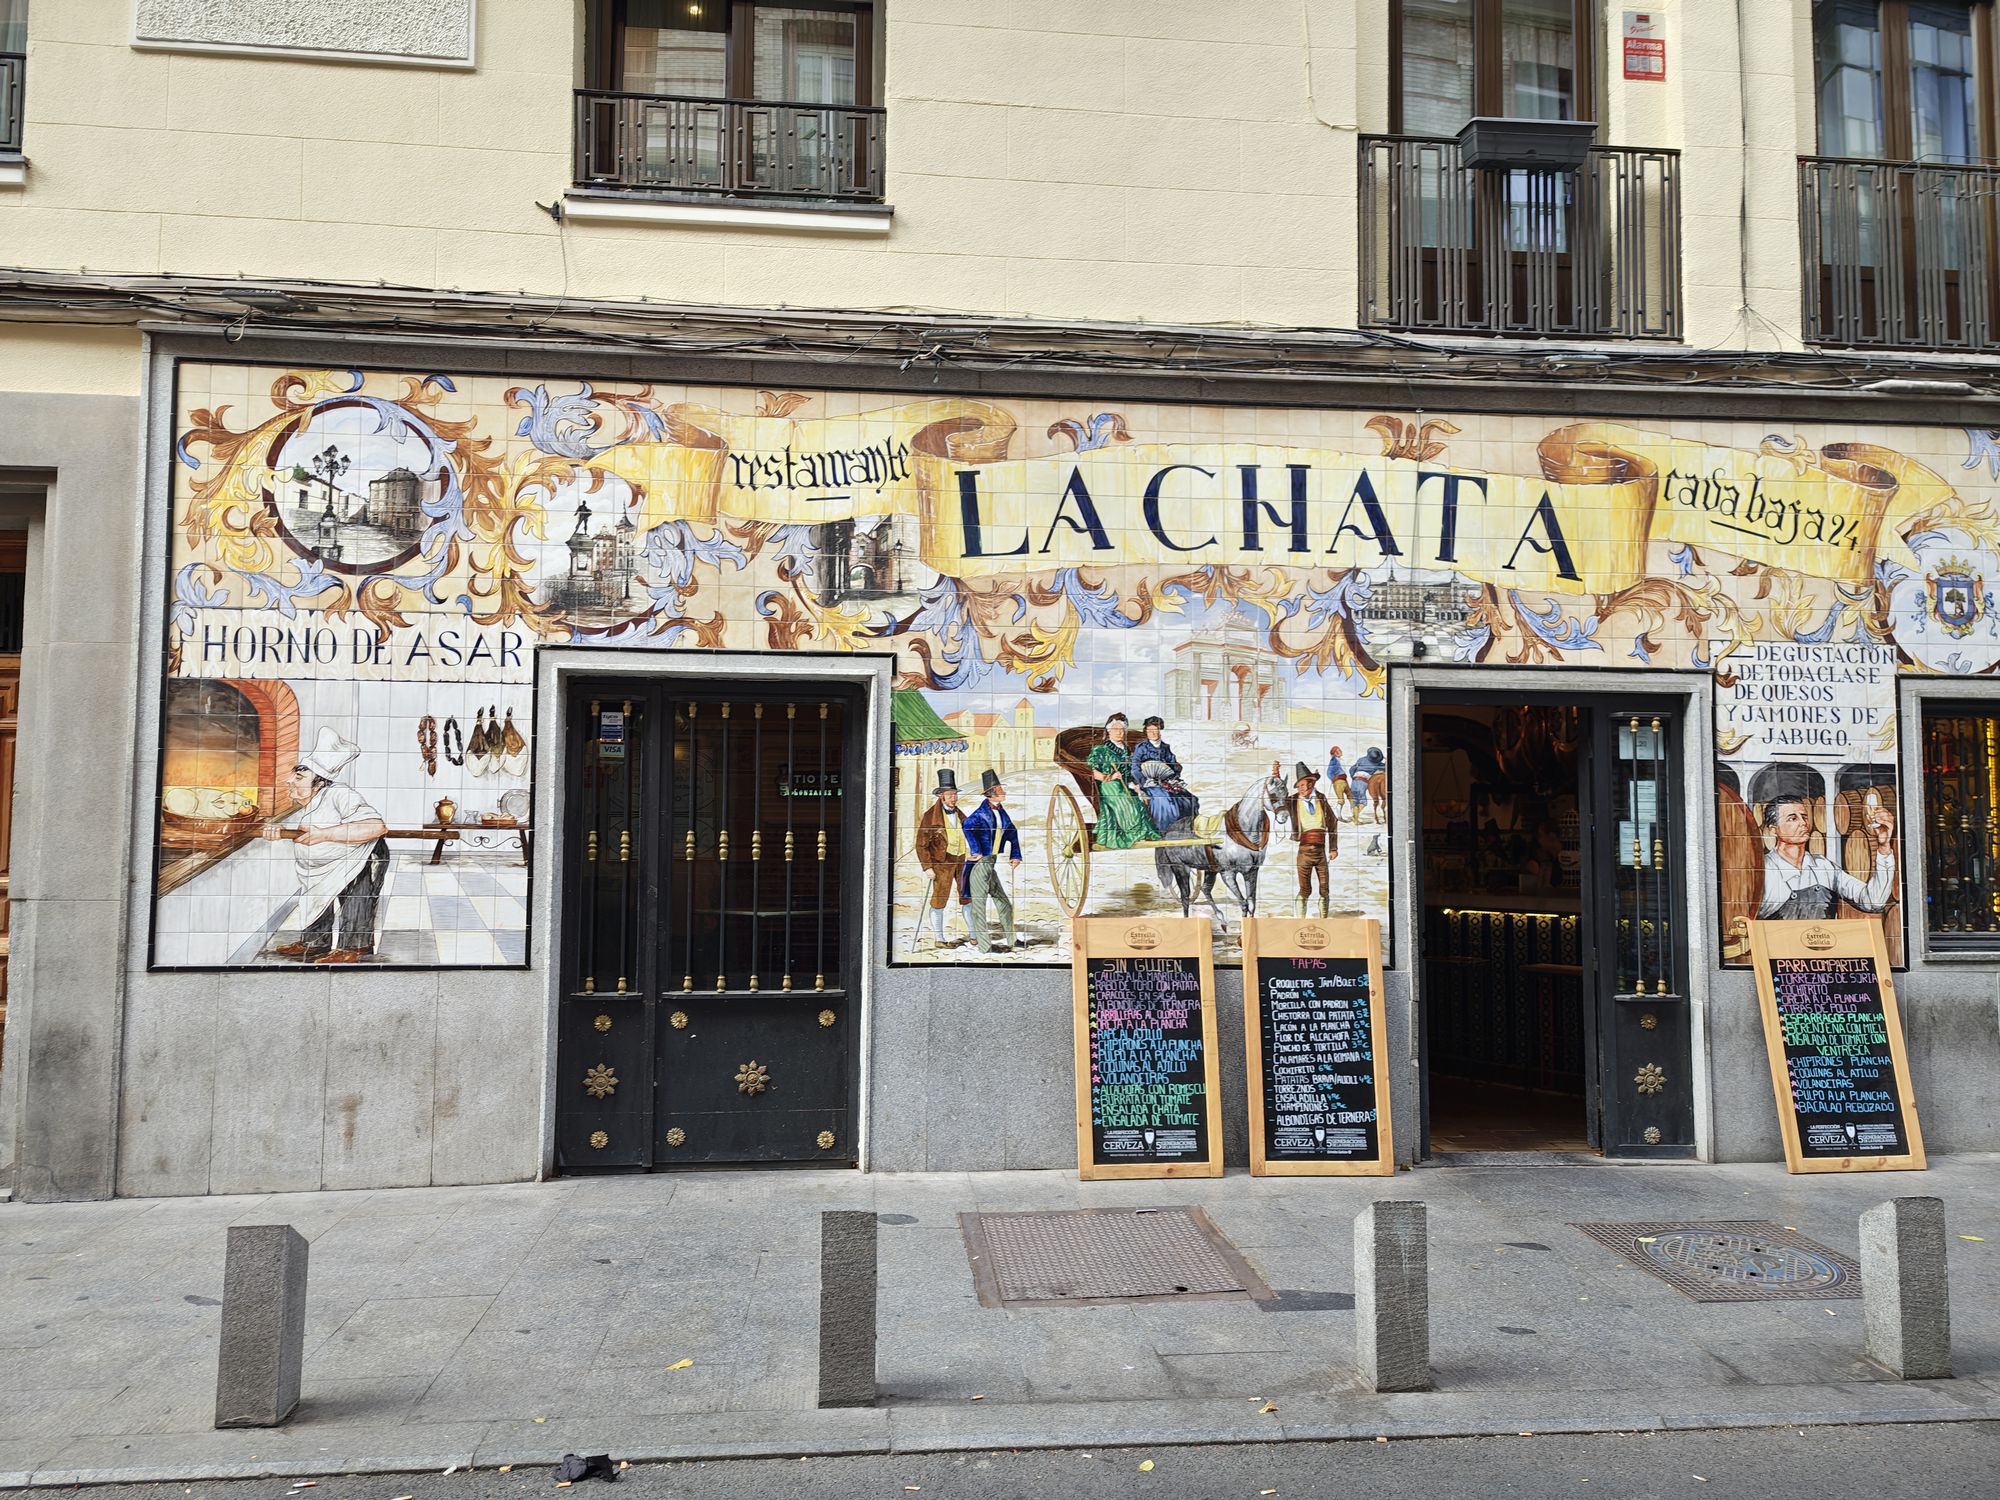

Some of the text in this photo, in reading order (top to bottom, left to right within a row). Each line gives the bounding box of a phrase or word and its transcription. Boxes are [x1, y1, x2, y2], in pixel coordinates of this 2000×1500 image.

[729, 435, 911, 494] restaurante
[1663, 468, 1740, 519] cava
[1745, 472, 1825, 545] baja
[954, 462, 1584, 582] LA CHATA
[202, 624, 522, 668] HORNO DE ASAR
[1757, 646, 1894, 664] DEGUSTACIÓN
[1735, 684, 1834, 702] DE QUESOS
[1726, 706, 1878, 725] Y JAMONES DE
[1762, 728, 1852, 746] JABUGO.
[794, 775, 815, 783] TIO
[1104, 959, 1182, 973] SIN GLUTEN
[1290, 959, 1327, 968] TAPAS
[1777, 959, 1869, 973] PARA COMPARTIR
[1777, 973, 1834, 984] TORREZNOS
[1835, 973, 1848, 984] DE
[1095, 980, 1199, 991] RABO DE TORO CON PATATA
[1780, 984, 1828, 995] COCHIFRITO
[1096, 992, 1176, 1000] CARACOLES EN SALSA
[1782, 996, 1811, 1004] OREJA
[1821, 995, 1831, 1003] LA
[1834, 993, 1871, 1003] PLANCHA
[1148, 1001, 1156, 1010] DE
[1160, 1000, 1201, 1010] TERNERA
[1271, 1001, 1306, 1010] MORCILLA
[1308, 1000, 1320, 1008] CON
[1783, 1004, 1857, 1013] TIRAS DE POLLO
[1145, 1010, 1152, 1019] AL
[1312, 1011, 1325, 1020] CON
[1329, 1011, 1355, 1020] PATATA
[1784, 1013, 1885, 1024] ESPARRAGOS PLANCHA
[1127, 1020, 1133, 1029] A
[1136, 1020, 1146, 1029] LA
[1151, 1020, 1188, 1029] PLANCHA
[1310, 1023, 1318, 1031] LA
[1321, 1021, 1350, 1031] PLANCHA
[1786, 1022, 1886, 1034] BERENJENA CON MIEL
[1120, 1029, 1128, 1040] AL
[1295, 1033, 1305, 1042] DE
[1310, 1031, 1349, 1040] ALCACHOFA
[1787, 1034, 1886, 1046] ENSALADA DE TOMATE CON
[1098, 1040, 1202, 1050] CHIPIRONES A LA PLANCHA
[1314, 1041, 1348, 1051] TORTILLA
[1817, 1045, 1870, 1056] VENTRESCA
[1098, 1050, 1197, 1061] PULPO A LA PLANCHA
[1317, 1054, 1322, 1062] A
[1324, 1054, 1333, 1063] LA
[1334, 1052, 1360, 1063] ROMANA
[1099, 1061, 1186, 1073] COQUINAS AL AJILLO
[1791, 1056, 1892, 1068] CHIPIRONES PLANCHA
[1101, 1073, 1169, 1084] VOLANDEIRAS
[1794, 1068, 1878, 1079] COQUINAS AL AJILLO
[1275, 1075, 1309, 1084] PATATAS
[1797, 1079, 1854, 1088] VOLANDEIRAS
[1148, 1085, 1165, 1094] CON
[1274, 1085, 1316, 1093] TORREZNOS
[1101, 1095, 1192, 1105] BURRATA CON TOMATE
[1275, 1094, 1327, 1103] ENSALADILLA
[1797, 1090, 1890, 1100] PULPO A LA PLANCHA
[1102, 1105, 1180, 1116] ENSALADA CHATA
[1799, 1102, 1894, 1113] BACALAO REBOZADO
[1102, 1113, 1199, 1127] ENSALADA DE TOMATE
[1326, 1114, 1337, 1124] DE
[1337, 1111, 1371, 1123] TERNERA
[1274, 1139, 1315, 1147] CERVEZA
